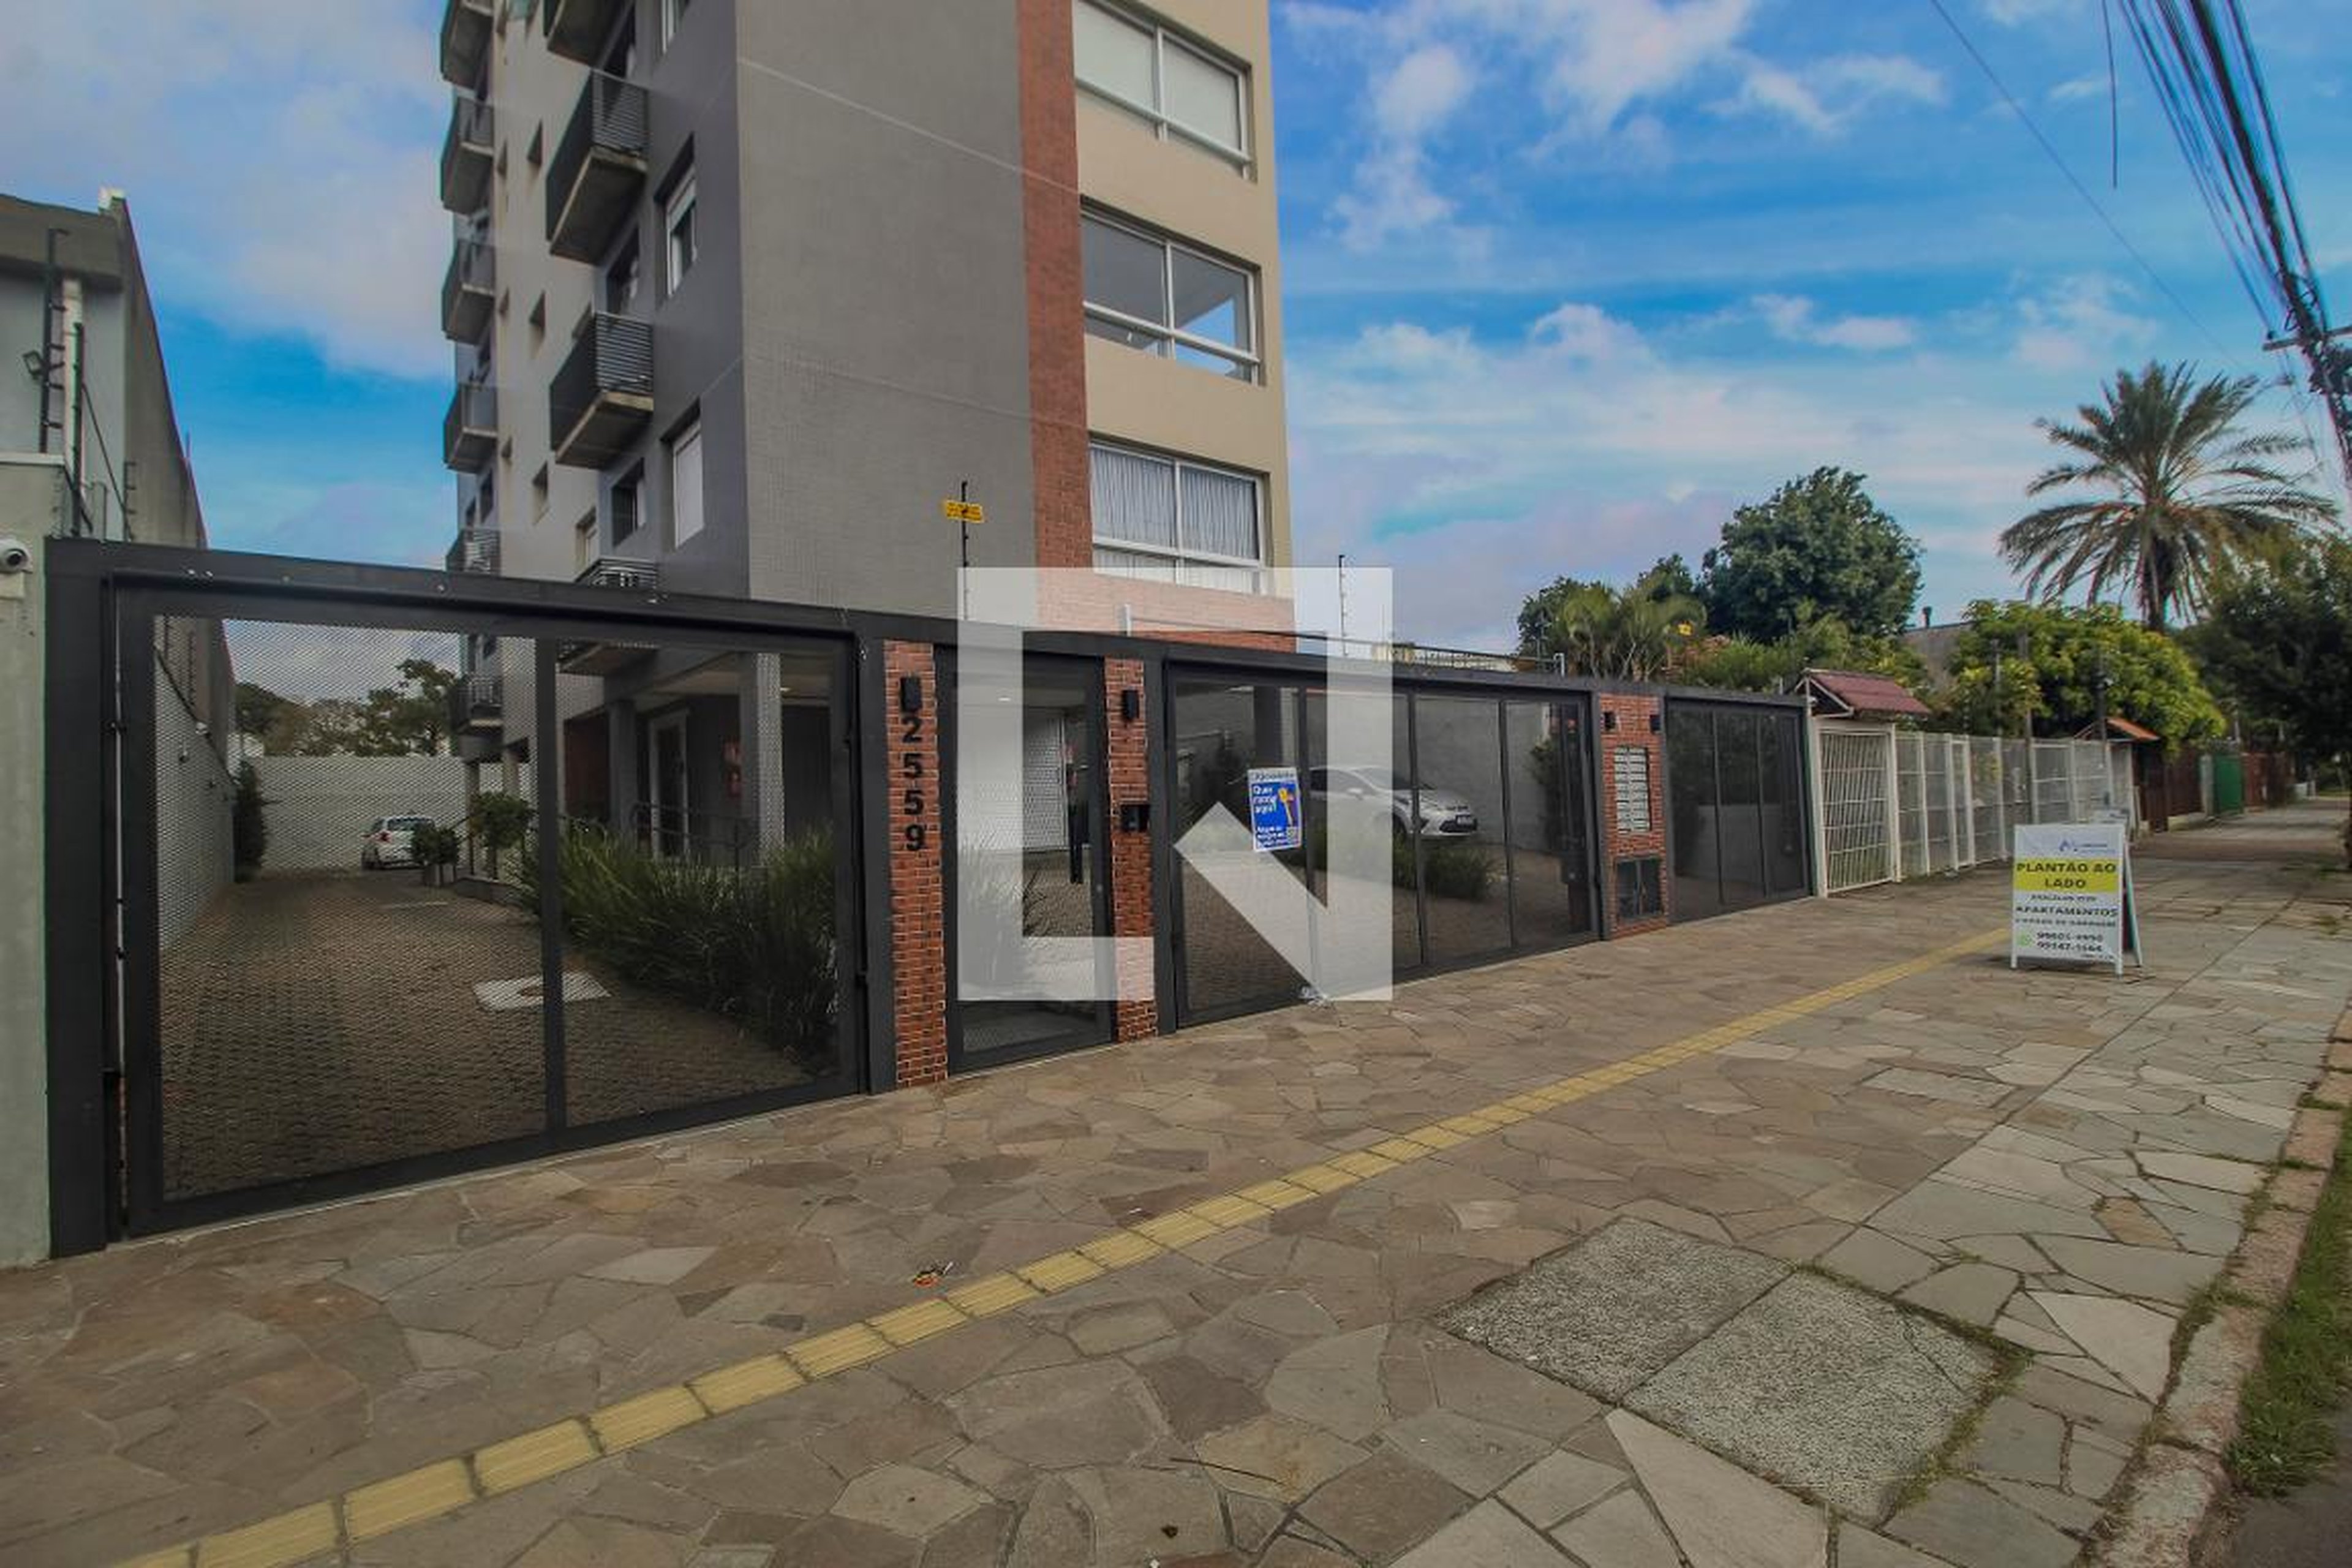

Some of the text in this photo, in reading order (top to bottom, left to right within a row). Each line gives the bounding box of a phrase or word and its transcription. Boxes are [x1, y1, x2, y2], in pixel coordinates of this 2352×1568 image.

[902, 715, 925, 851] 2559
[2016, 861, 2116, 873] PLANTÃO AO
[2045, 878, 2086, 889] LADO
[2016, 905, 2119, 917] APARTAMENTOS
